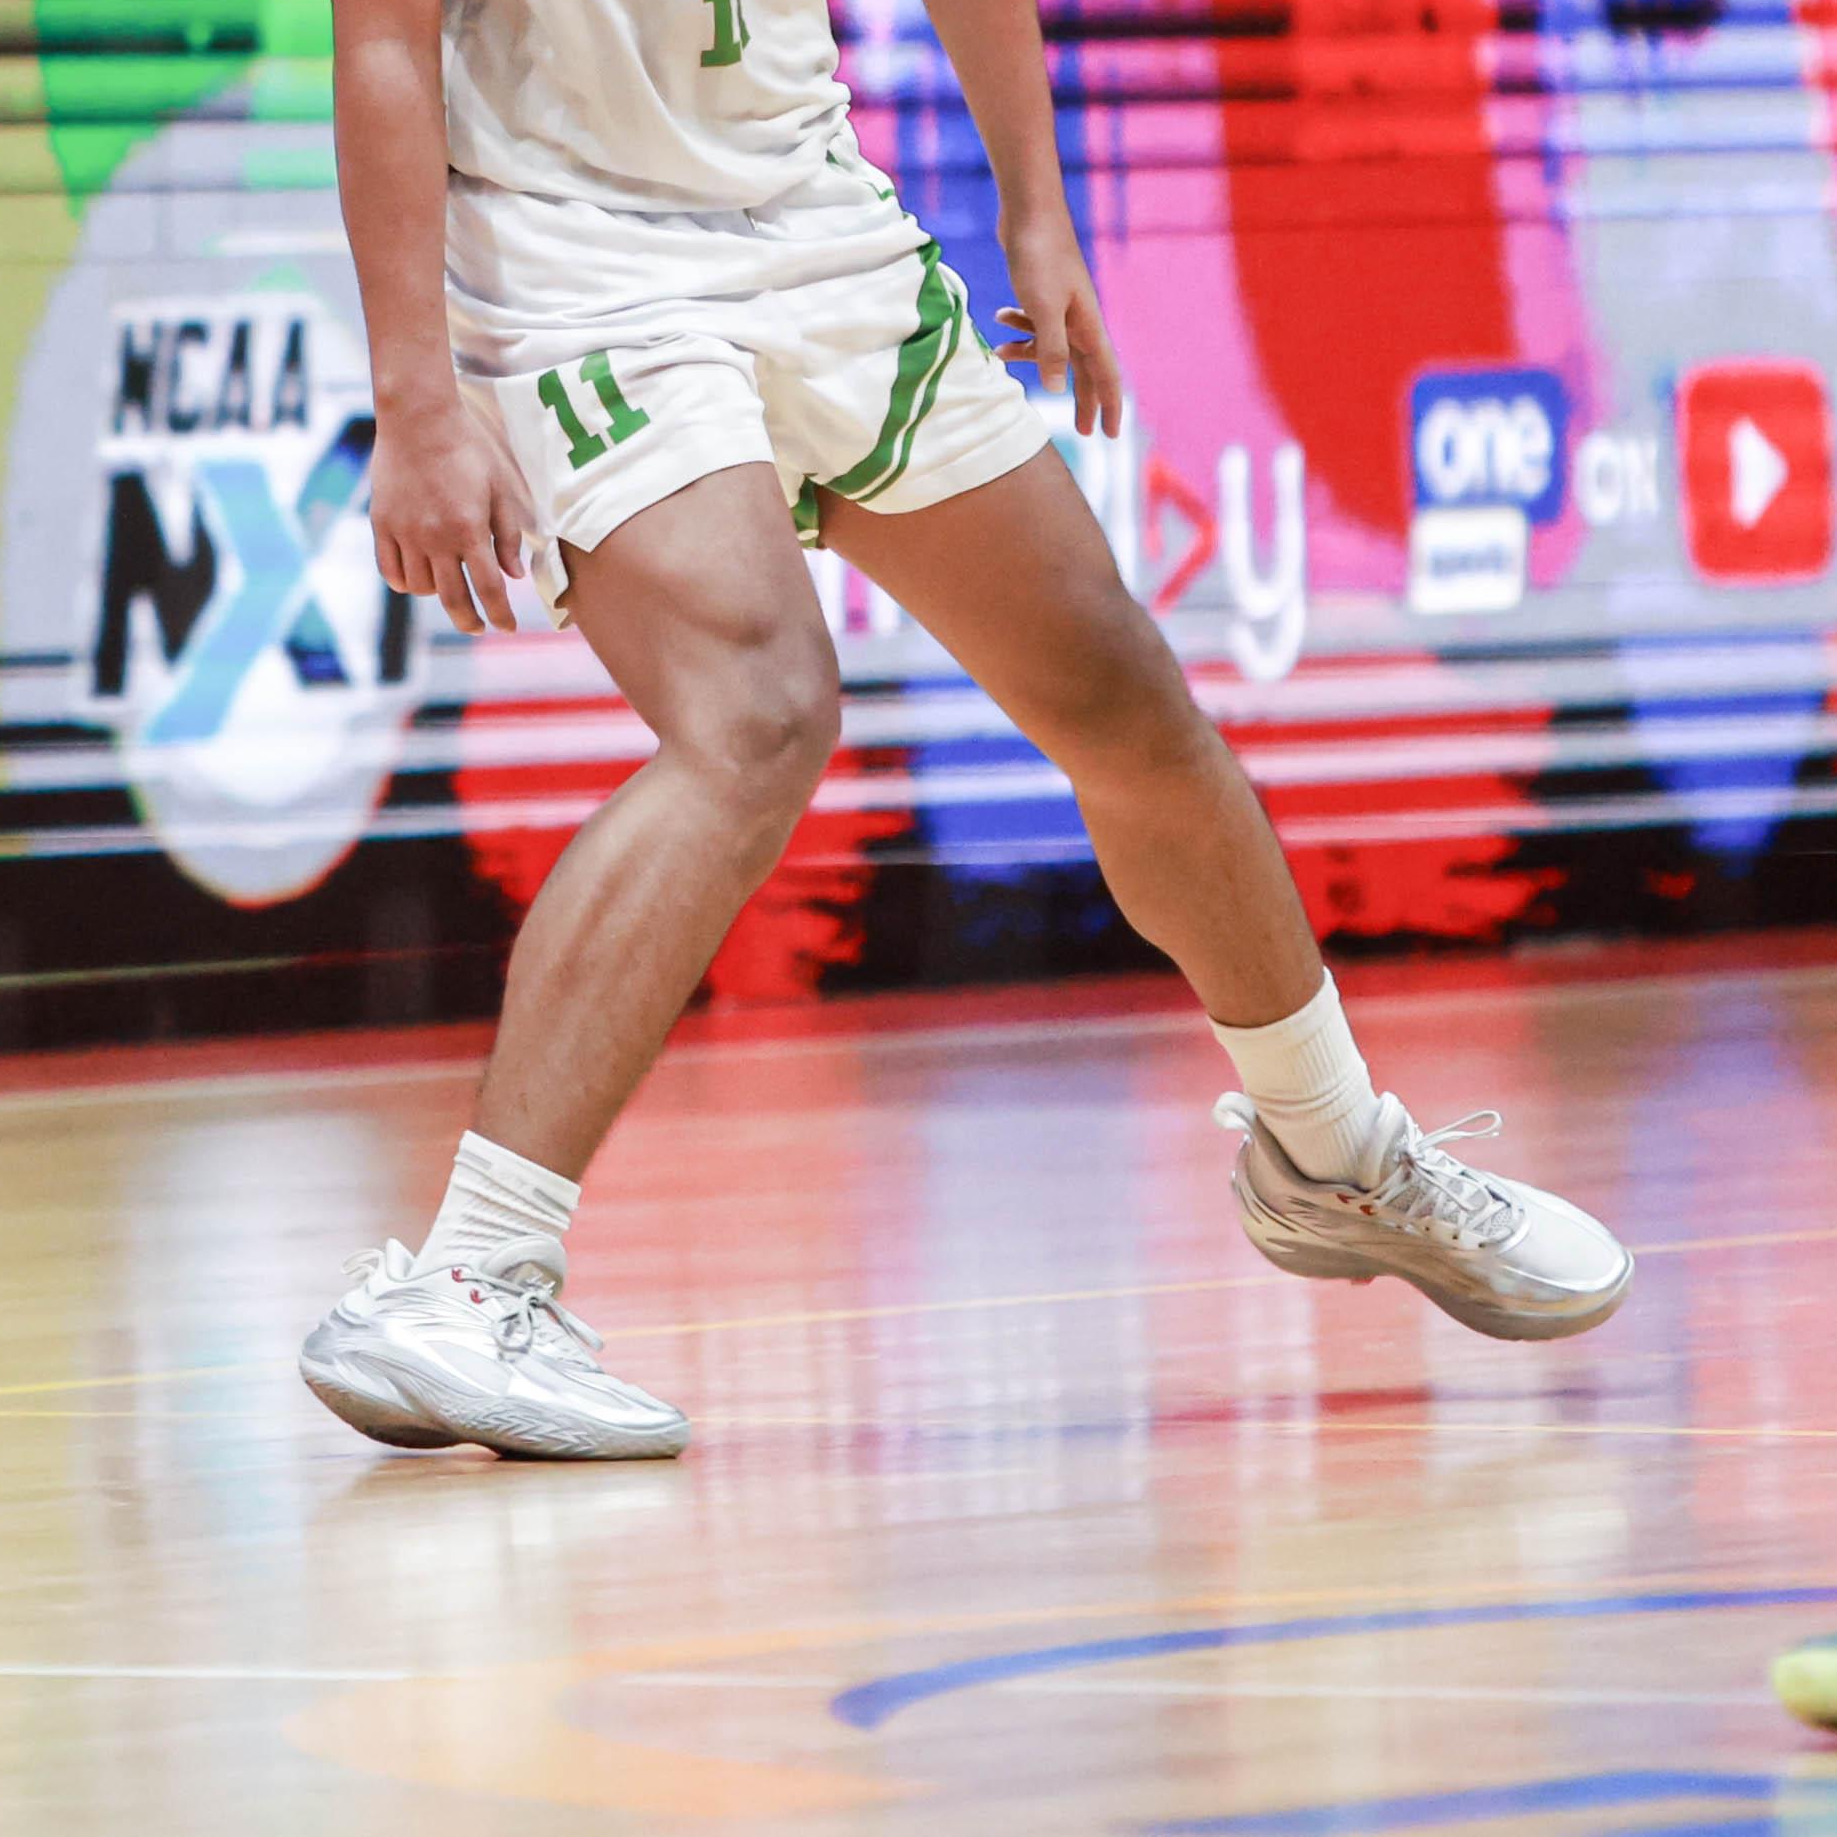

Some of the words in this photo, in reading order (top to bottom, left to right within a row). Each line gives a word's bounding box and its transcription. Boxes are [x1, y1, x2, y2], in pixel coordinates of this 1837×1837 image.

[113, 317, 306, 433] NCAA
[537, 350, 652, 470] 11
[1417, 395, 1555, 501] one
